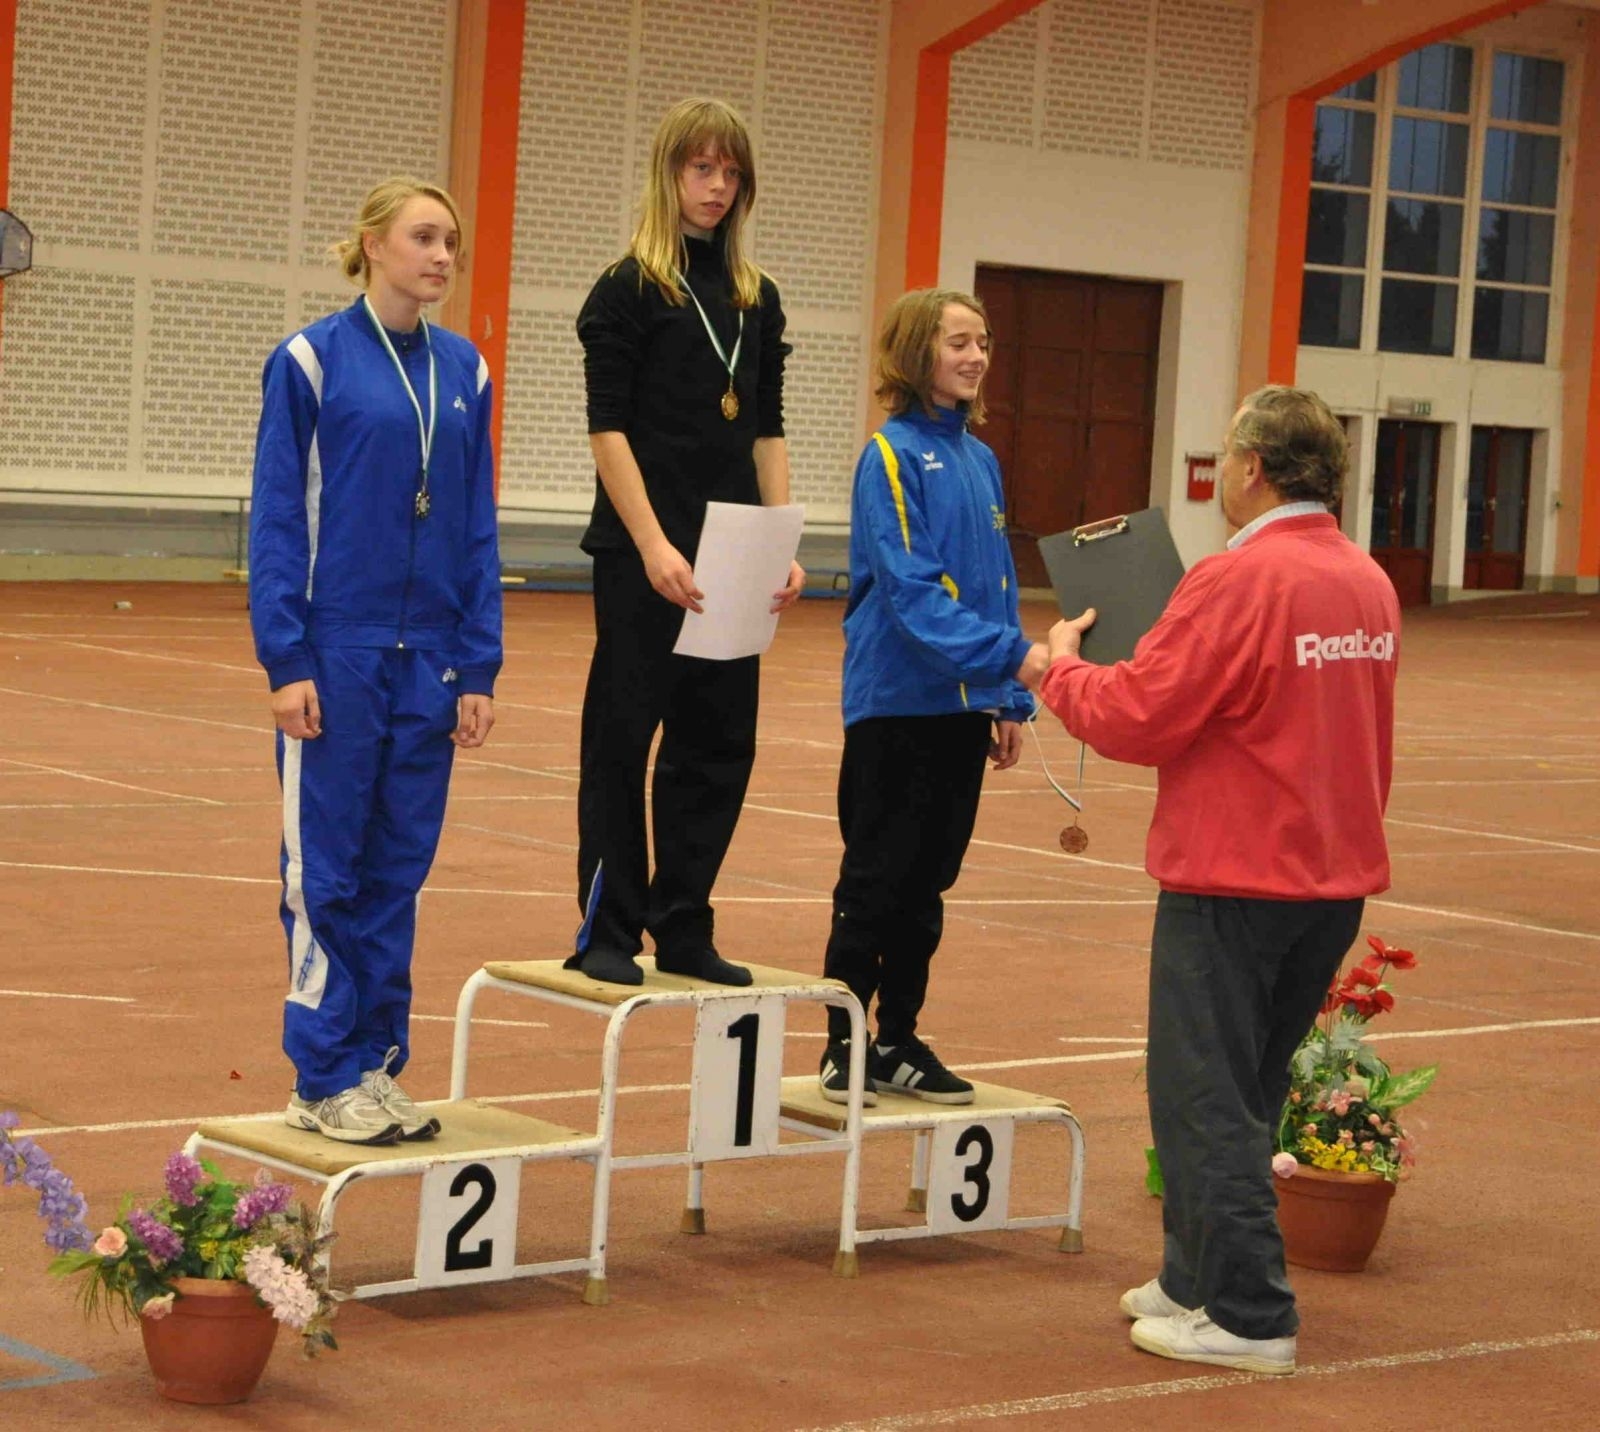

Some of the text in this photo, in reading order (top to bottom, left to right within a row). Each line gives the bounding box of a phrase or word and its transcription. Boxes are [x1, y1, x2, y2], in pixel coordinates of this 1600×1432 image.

[727, 1013, 760, 1147] 1
[444, 1163, 497, 1272] 2
[950, 1124, 994, 1223] 3
